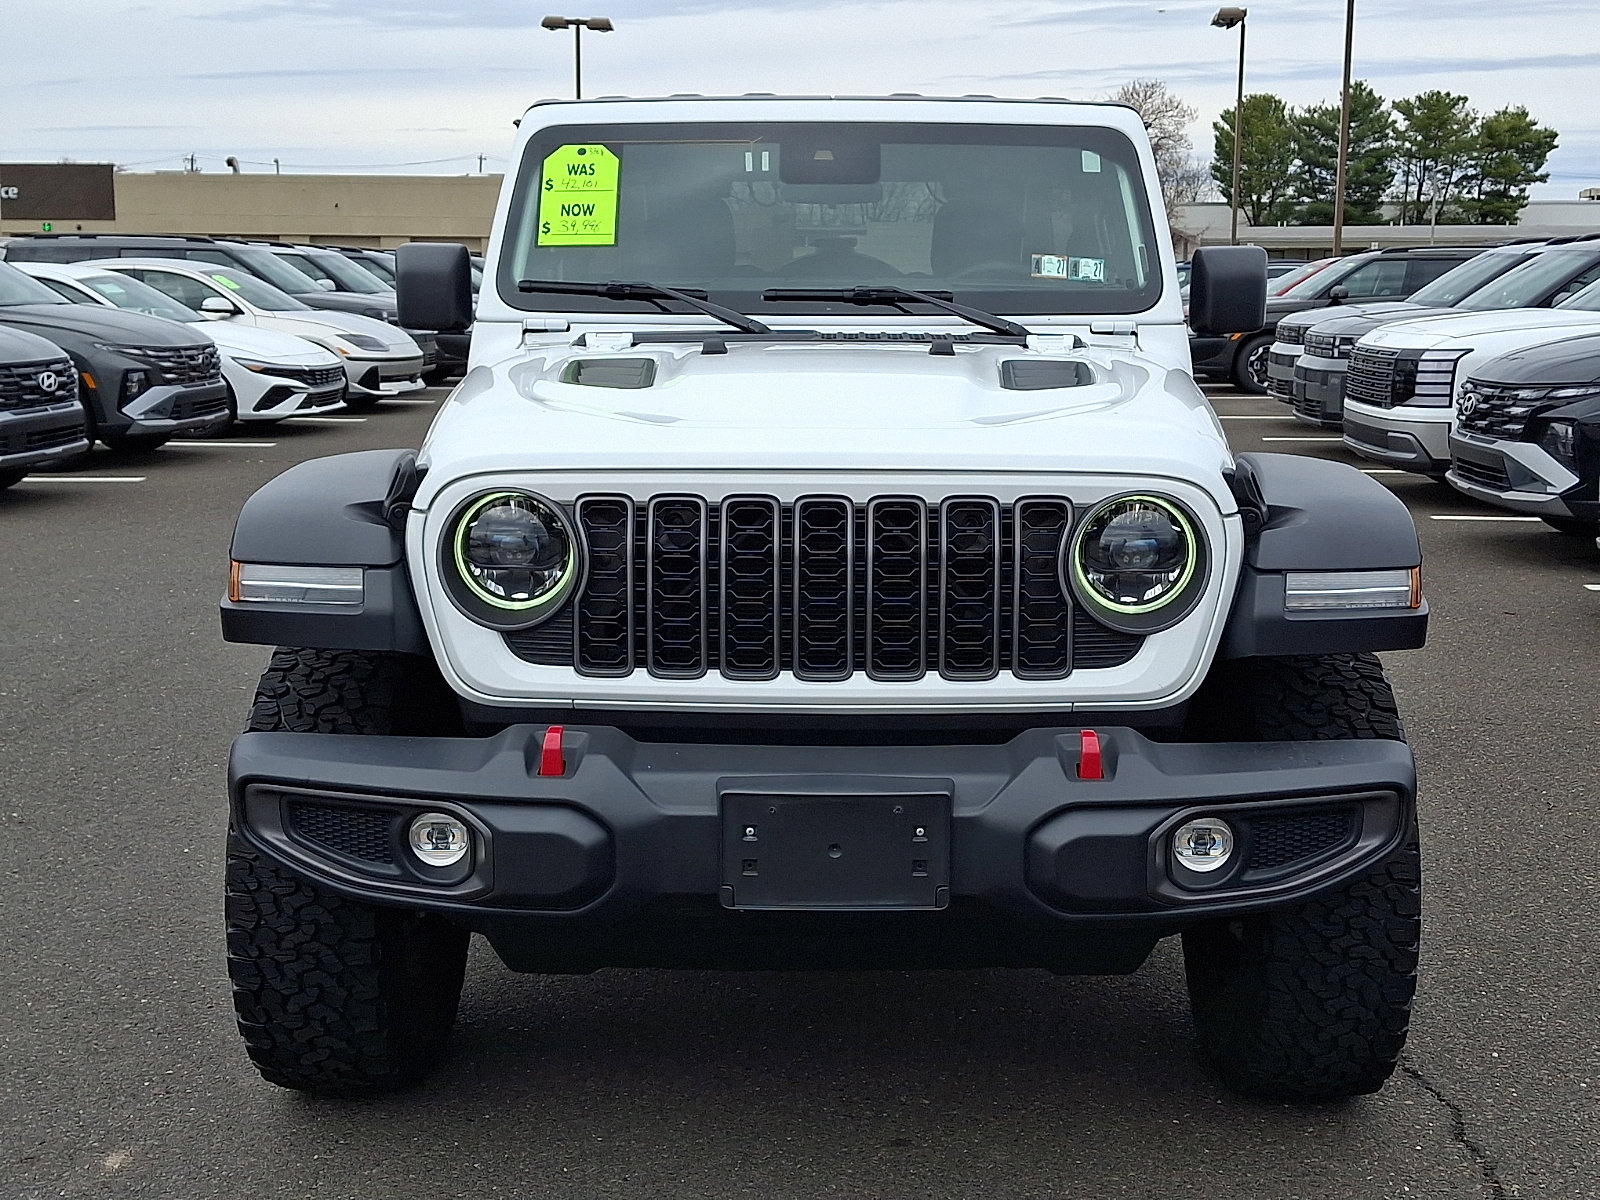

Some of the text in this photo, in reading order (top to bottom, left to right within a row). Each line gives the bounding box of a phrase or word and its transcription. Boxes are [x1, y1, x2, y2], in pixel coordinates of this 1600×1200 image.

[567, 163, 595, 176] WAS
[544, 178, 554, 192] $
[560, 204, 595, 216] NOW
[541, 221, 551, 235] $
